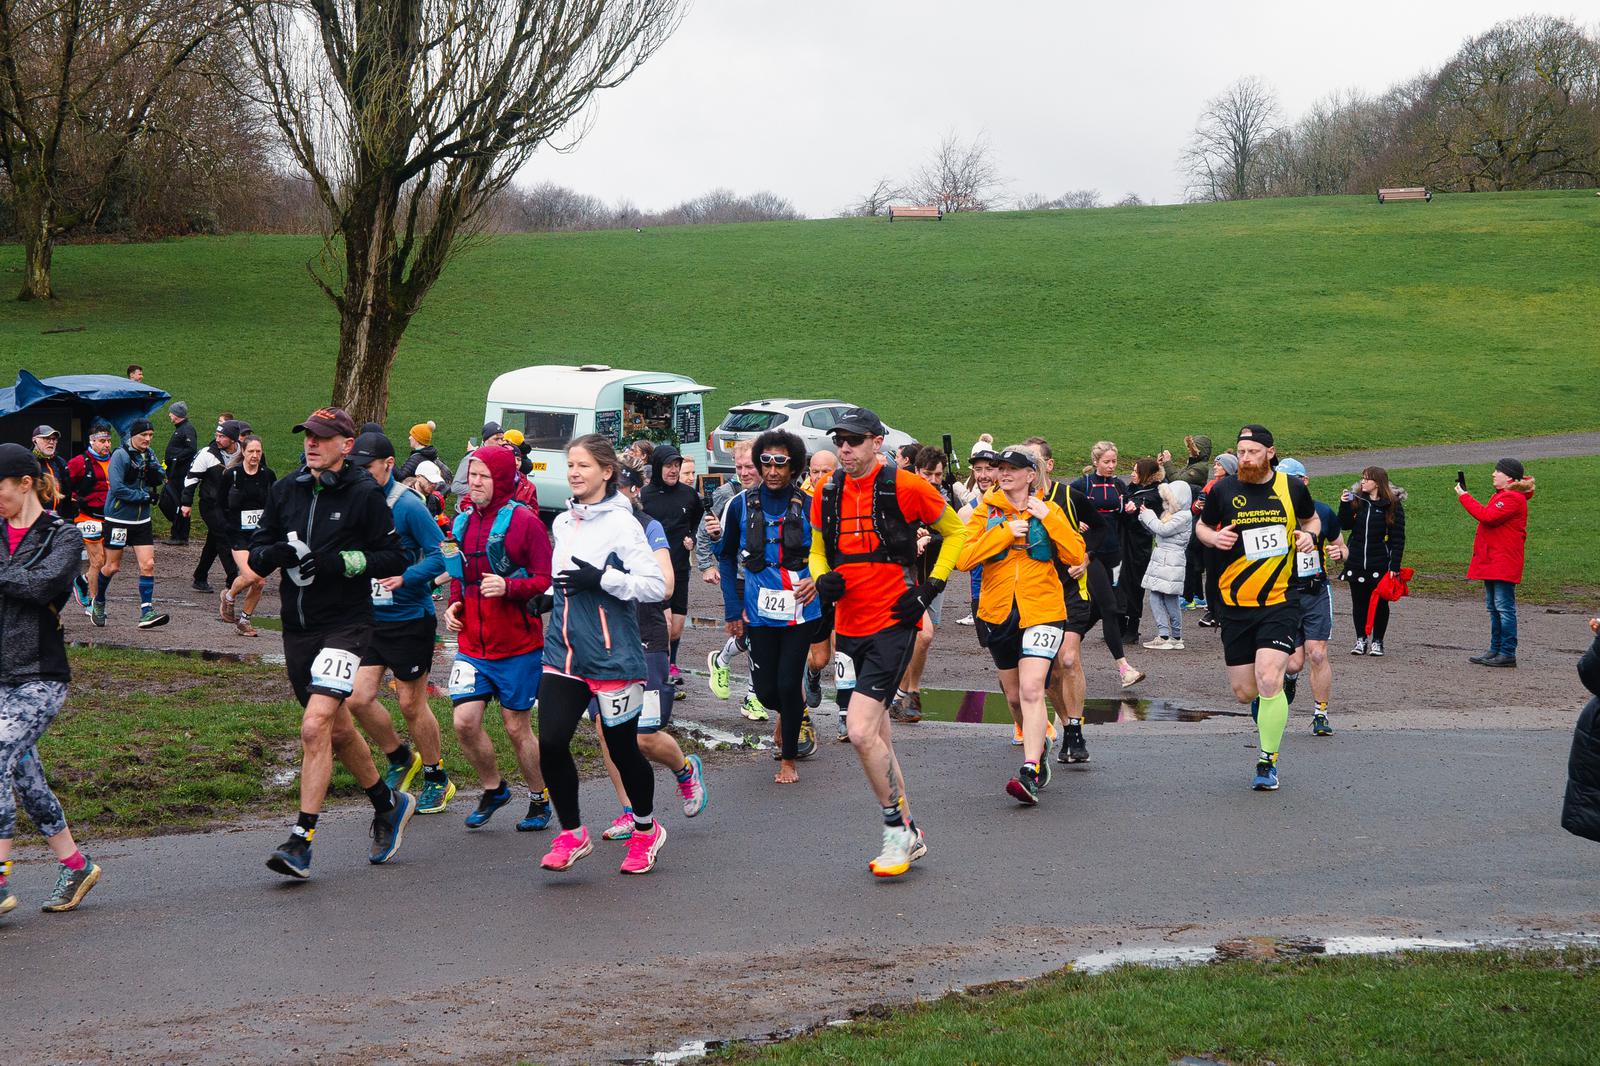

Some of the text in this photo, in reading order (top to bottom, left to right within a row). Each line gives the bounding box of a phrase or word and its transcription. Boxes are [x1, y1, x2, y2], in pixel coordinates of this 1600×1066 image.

[1231, 516, 1287, 525] ROADRUNNERS
[1237, 510, 1280, 518] RIVERSWAY
[83, 524, 97, 532] 193
[1255, 533, 1278, 550] 155
[1303, 556, 1314, 570] 54
[764, 596, 786, 612] 224
[1032, 632, 1056, 649] 237
[322, 658, 353, 680] 215
[612, 694, 631, 716] 57
